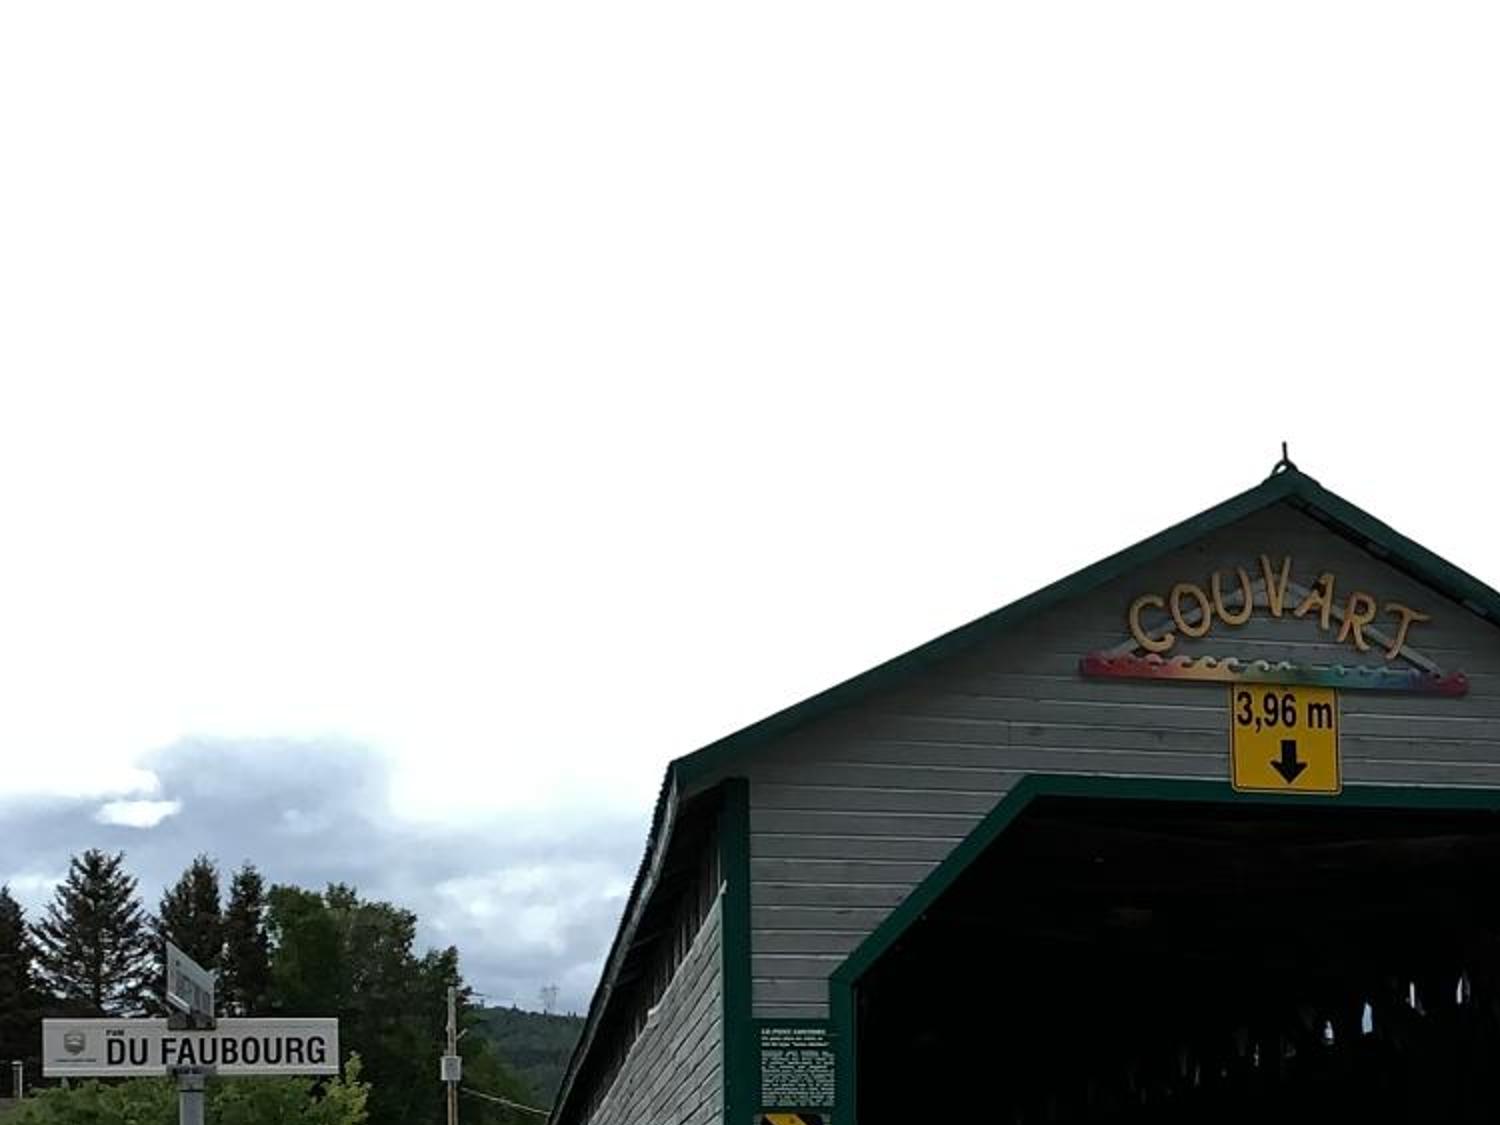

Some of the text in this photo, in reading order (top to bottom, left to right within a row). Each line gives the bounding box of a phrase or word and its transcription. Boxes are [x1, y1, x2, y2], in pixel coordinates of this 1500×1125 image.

[1127, 553, 1431, 661] COUVART
[1236, 692, 1333, 733] 3,96 m
[106, 1036, 326, 1066] DU FAUBOURG
